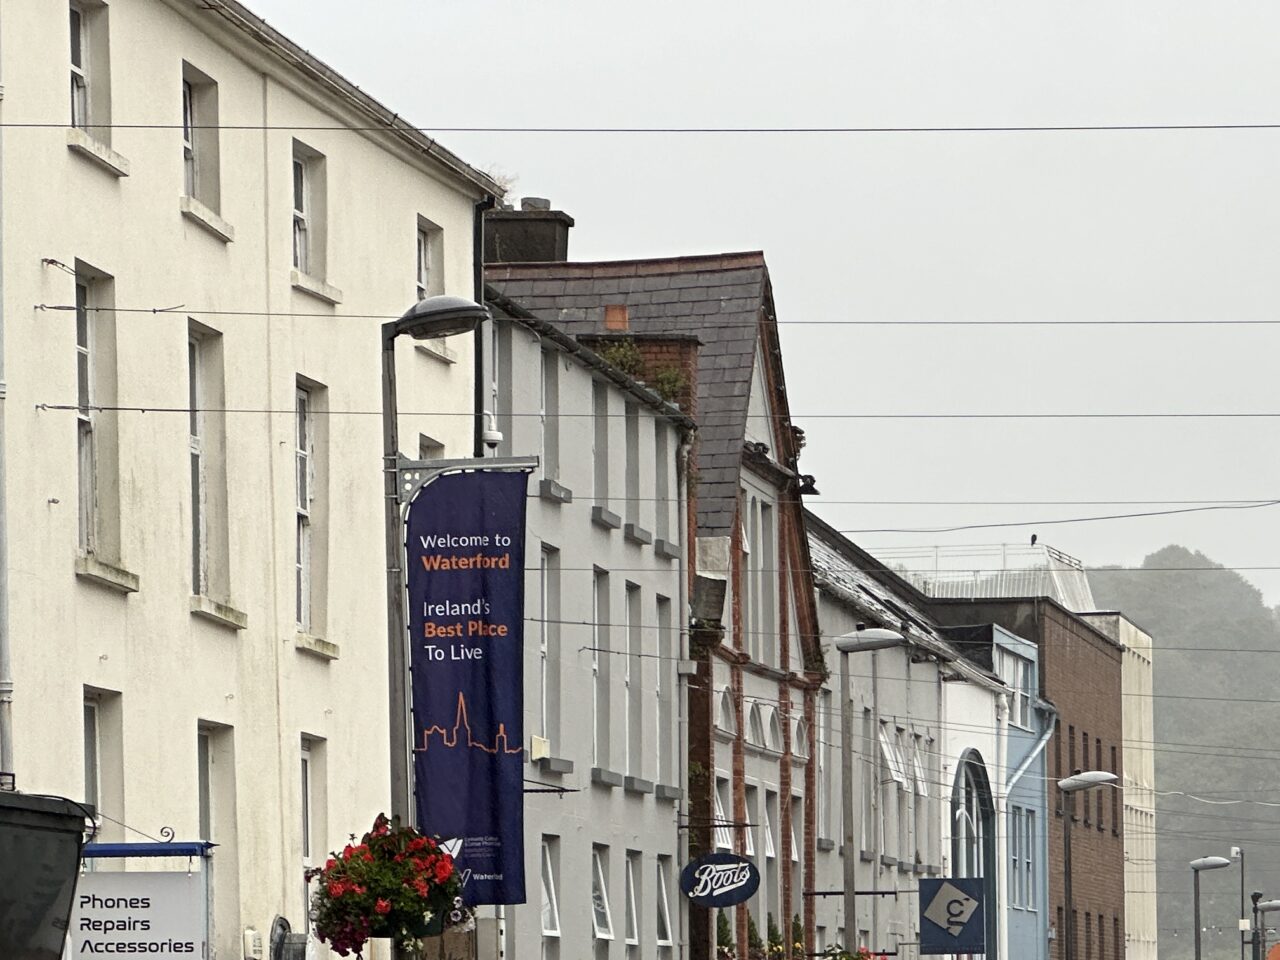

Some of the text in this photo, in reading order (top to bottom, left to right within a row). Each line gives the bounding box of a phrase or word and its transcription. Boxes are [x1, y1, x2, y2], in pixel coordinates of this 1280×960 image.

[420, 534, 511, 549] Welcome to
[421, 553, 510, 571] Waterford
[423, 599, 490, 616] Ireland's
[424, 620, 508, 637] Best Place
[424, 644, 483, 660] To Live
[689, 862, 751, 898] Boots
[80, 894, 150, 909] Phones
[80, 916, 150, 935] Repairs
[80, 938, 194, 953] Accessories
